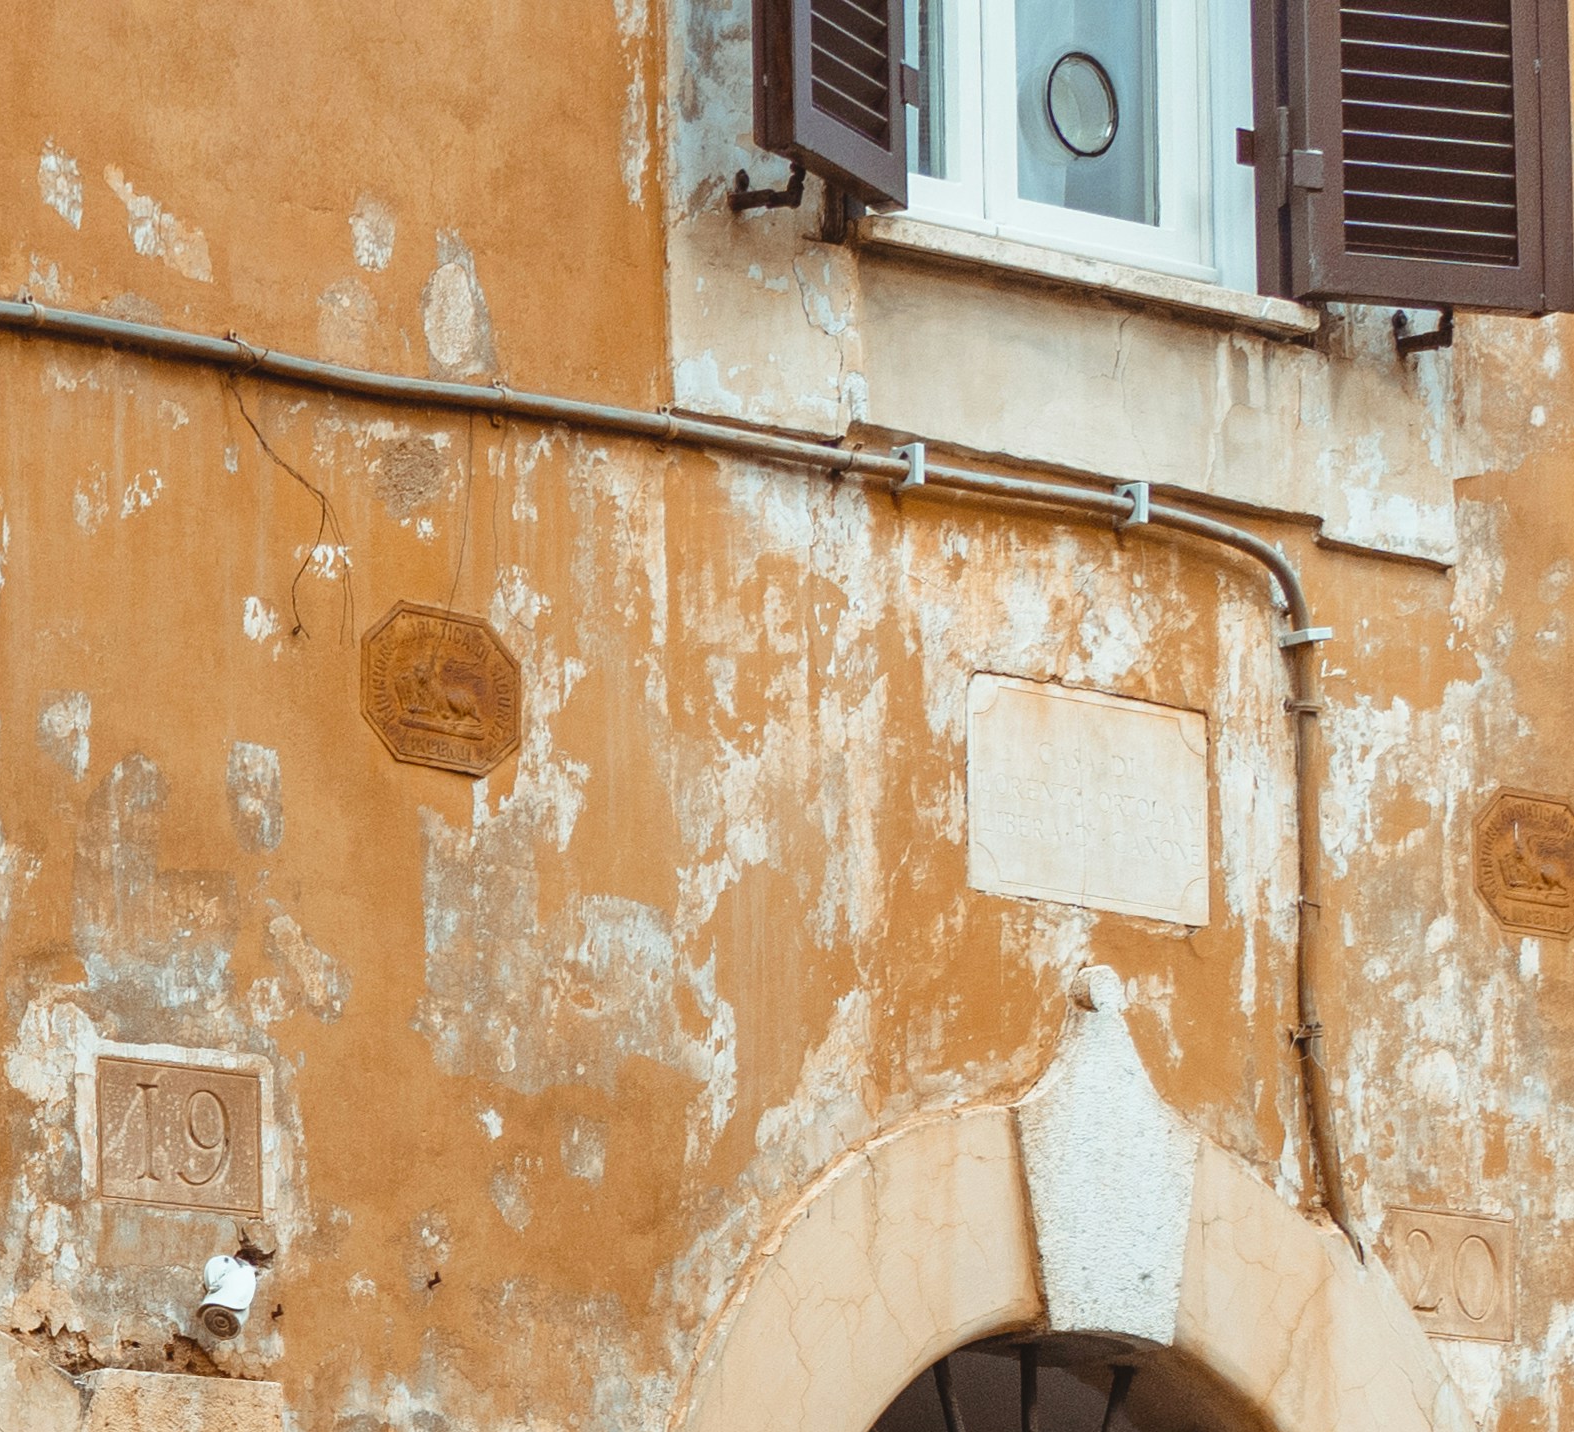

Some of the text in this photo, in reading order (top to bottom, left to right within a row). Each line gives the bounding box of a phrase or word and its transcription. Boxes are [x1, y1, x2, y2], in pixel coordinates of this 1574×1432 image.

[977, 768, 1203, 832] LORENZO ORTOLANI
[1112, 831, 1203, 867] CANONE
[135, 1082, 231, 1187] 19
